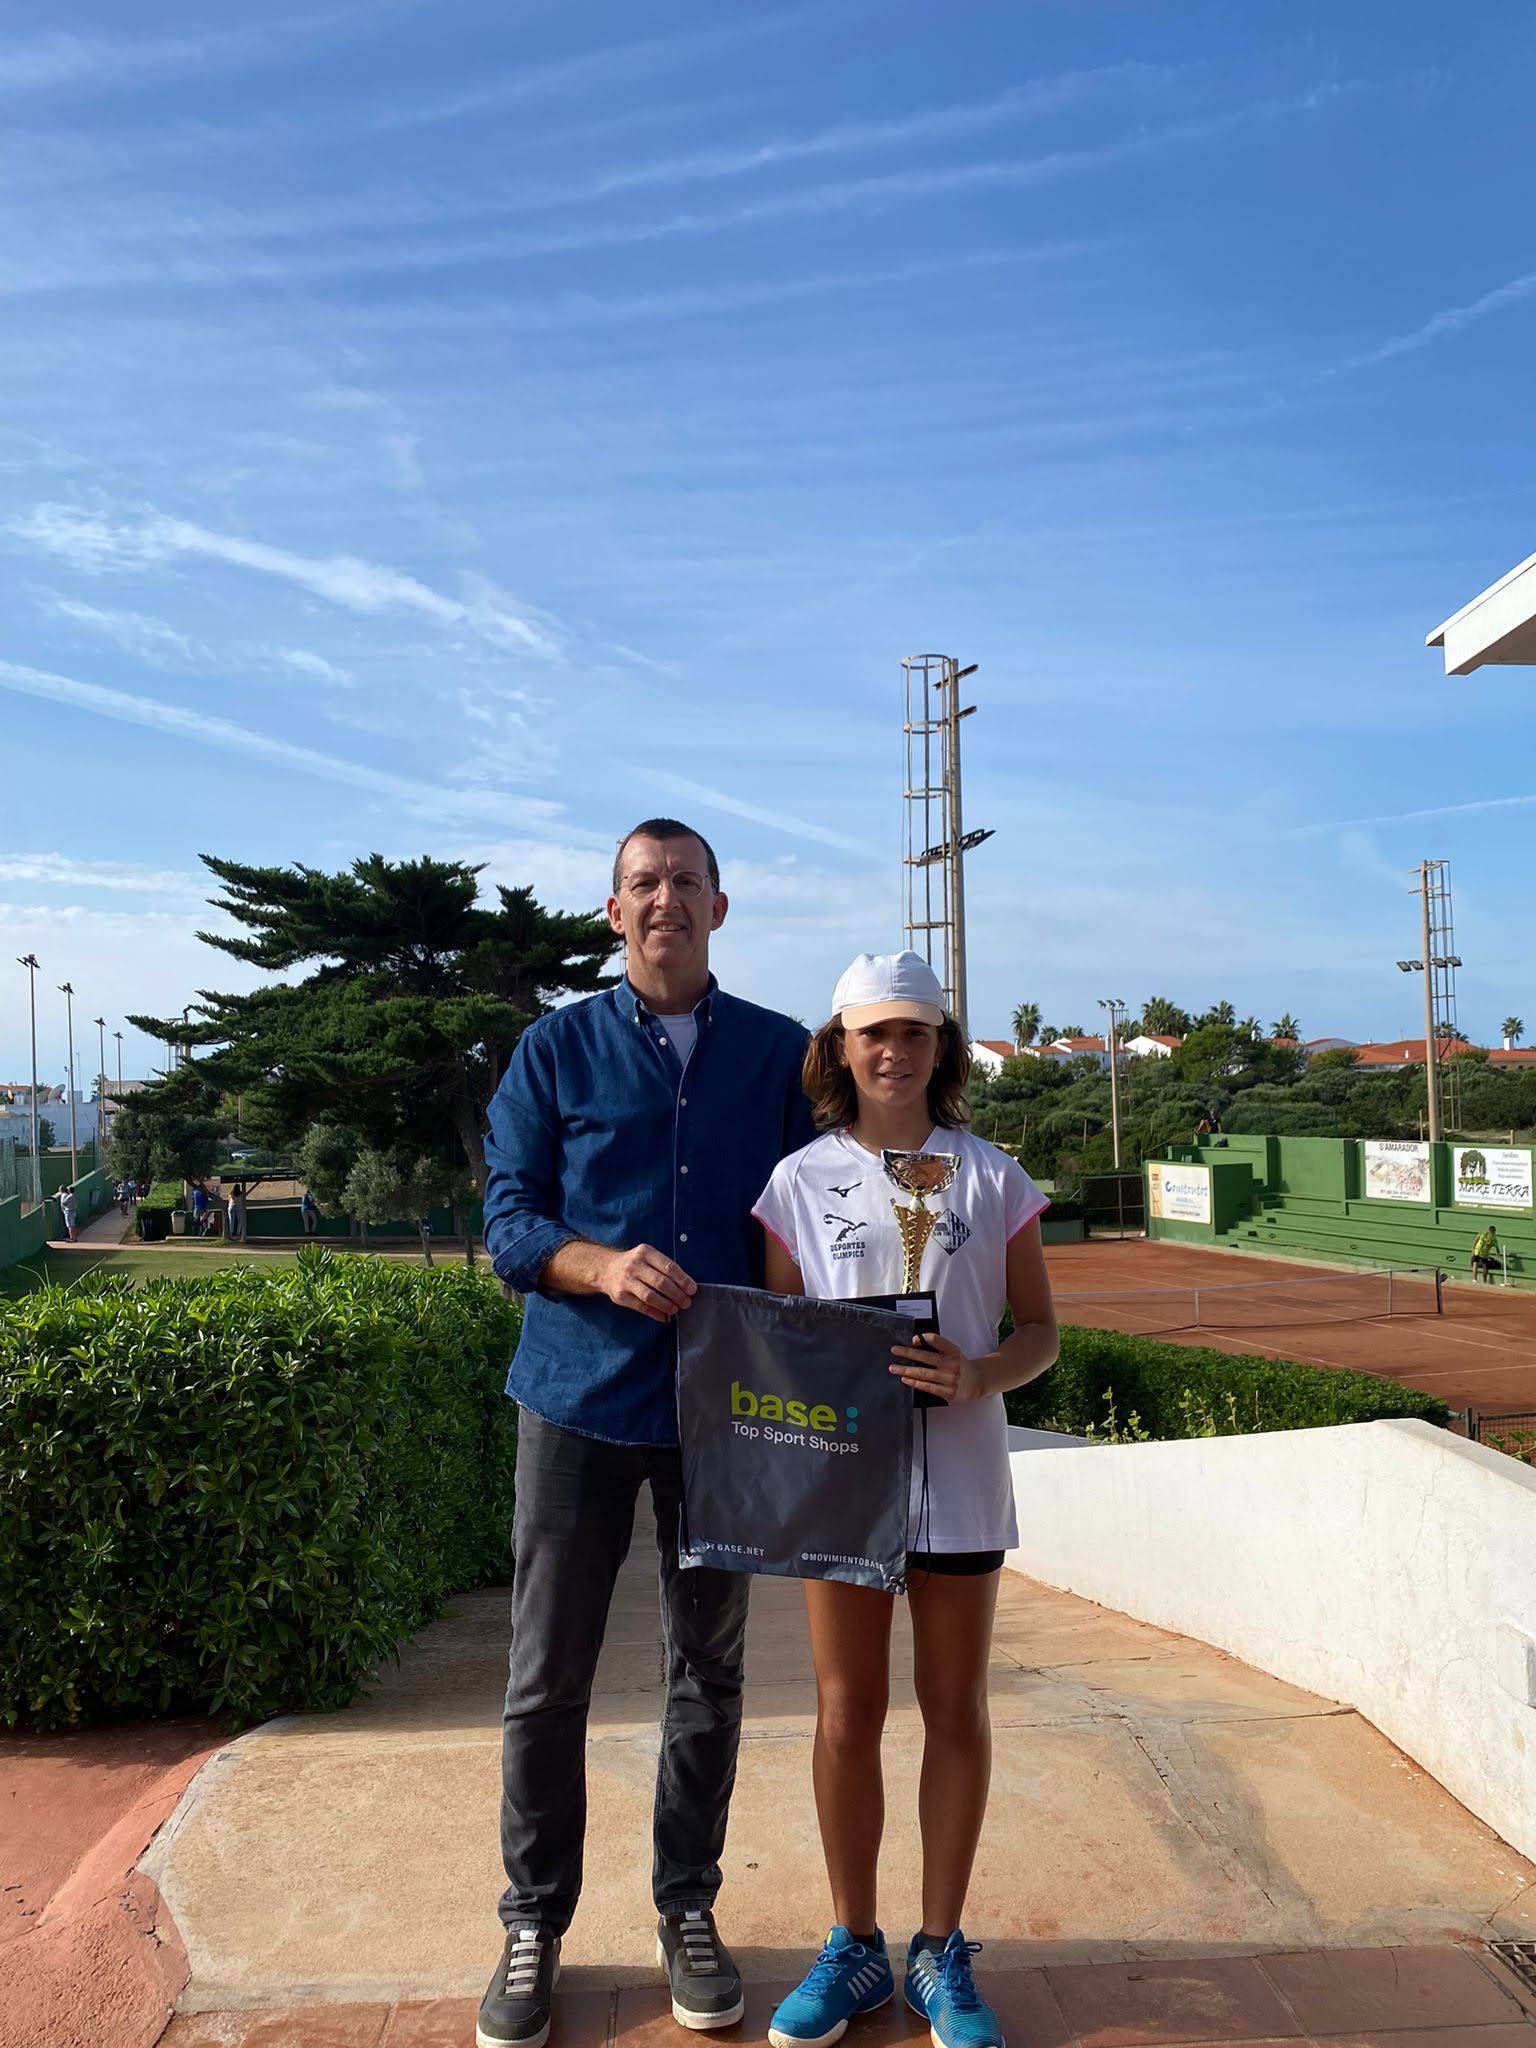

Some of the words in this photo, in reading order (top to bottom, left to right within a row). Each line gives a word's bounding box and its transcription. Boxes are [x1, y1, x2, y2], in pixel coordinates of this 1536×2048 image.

[1379, 1142, 1419, 1152] S'AMARADOR
[830, 1241, 866, 1252] DEPORTES
[833, 1250, 865, 1260] OLIMPICS
[731, 1421, 760, 1440] Top
[763, 1427, 806, 1445] Sport
[809, 1435, 859, 1455] Shops
